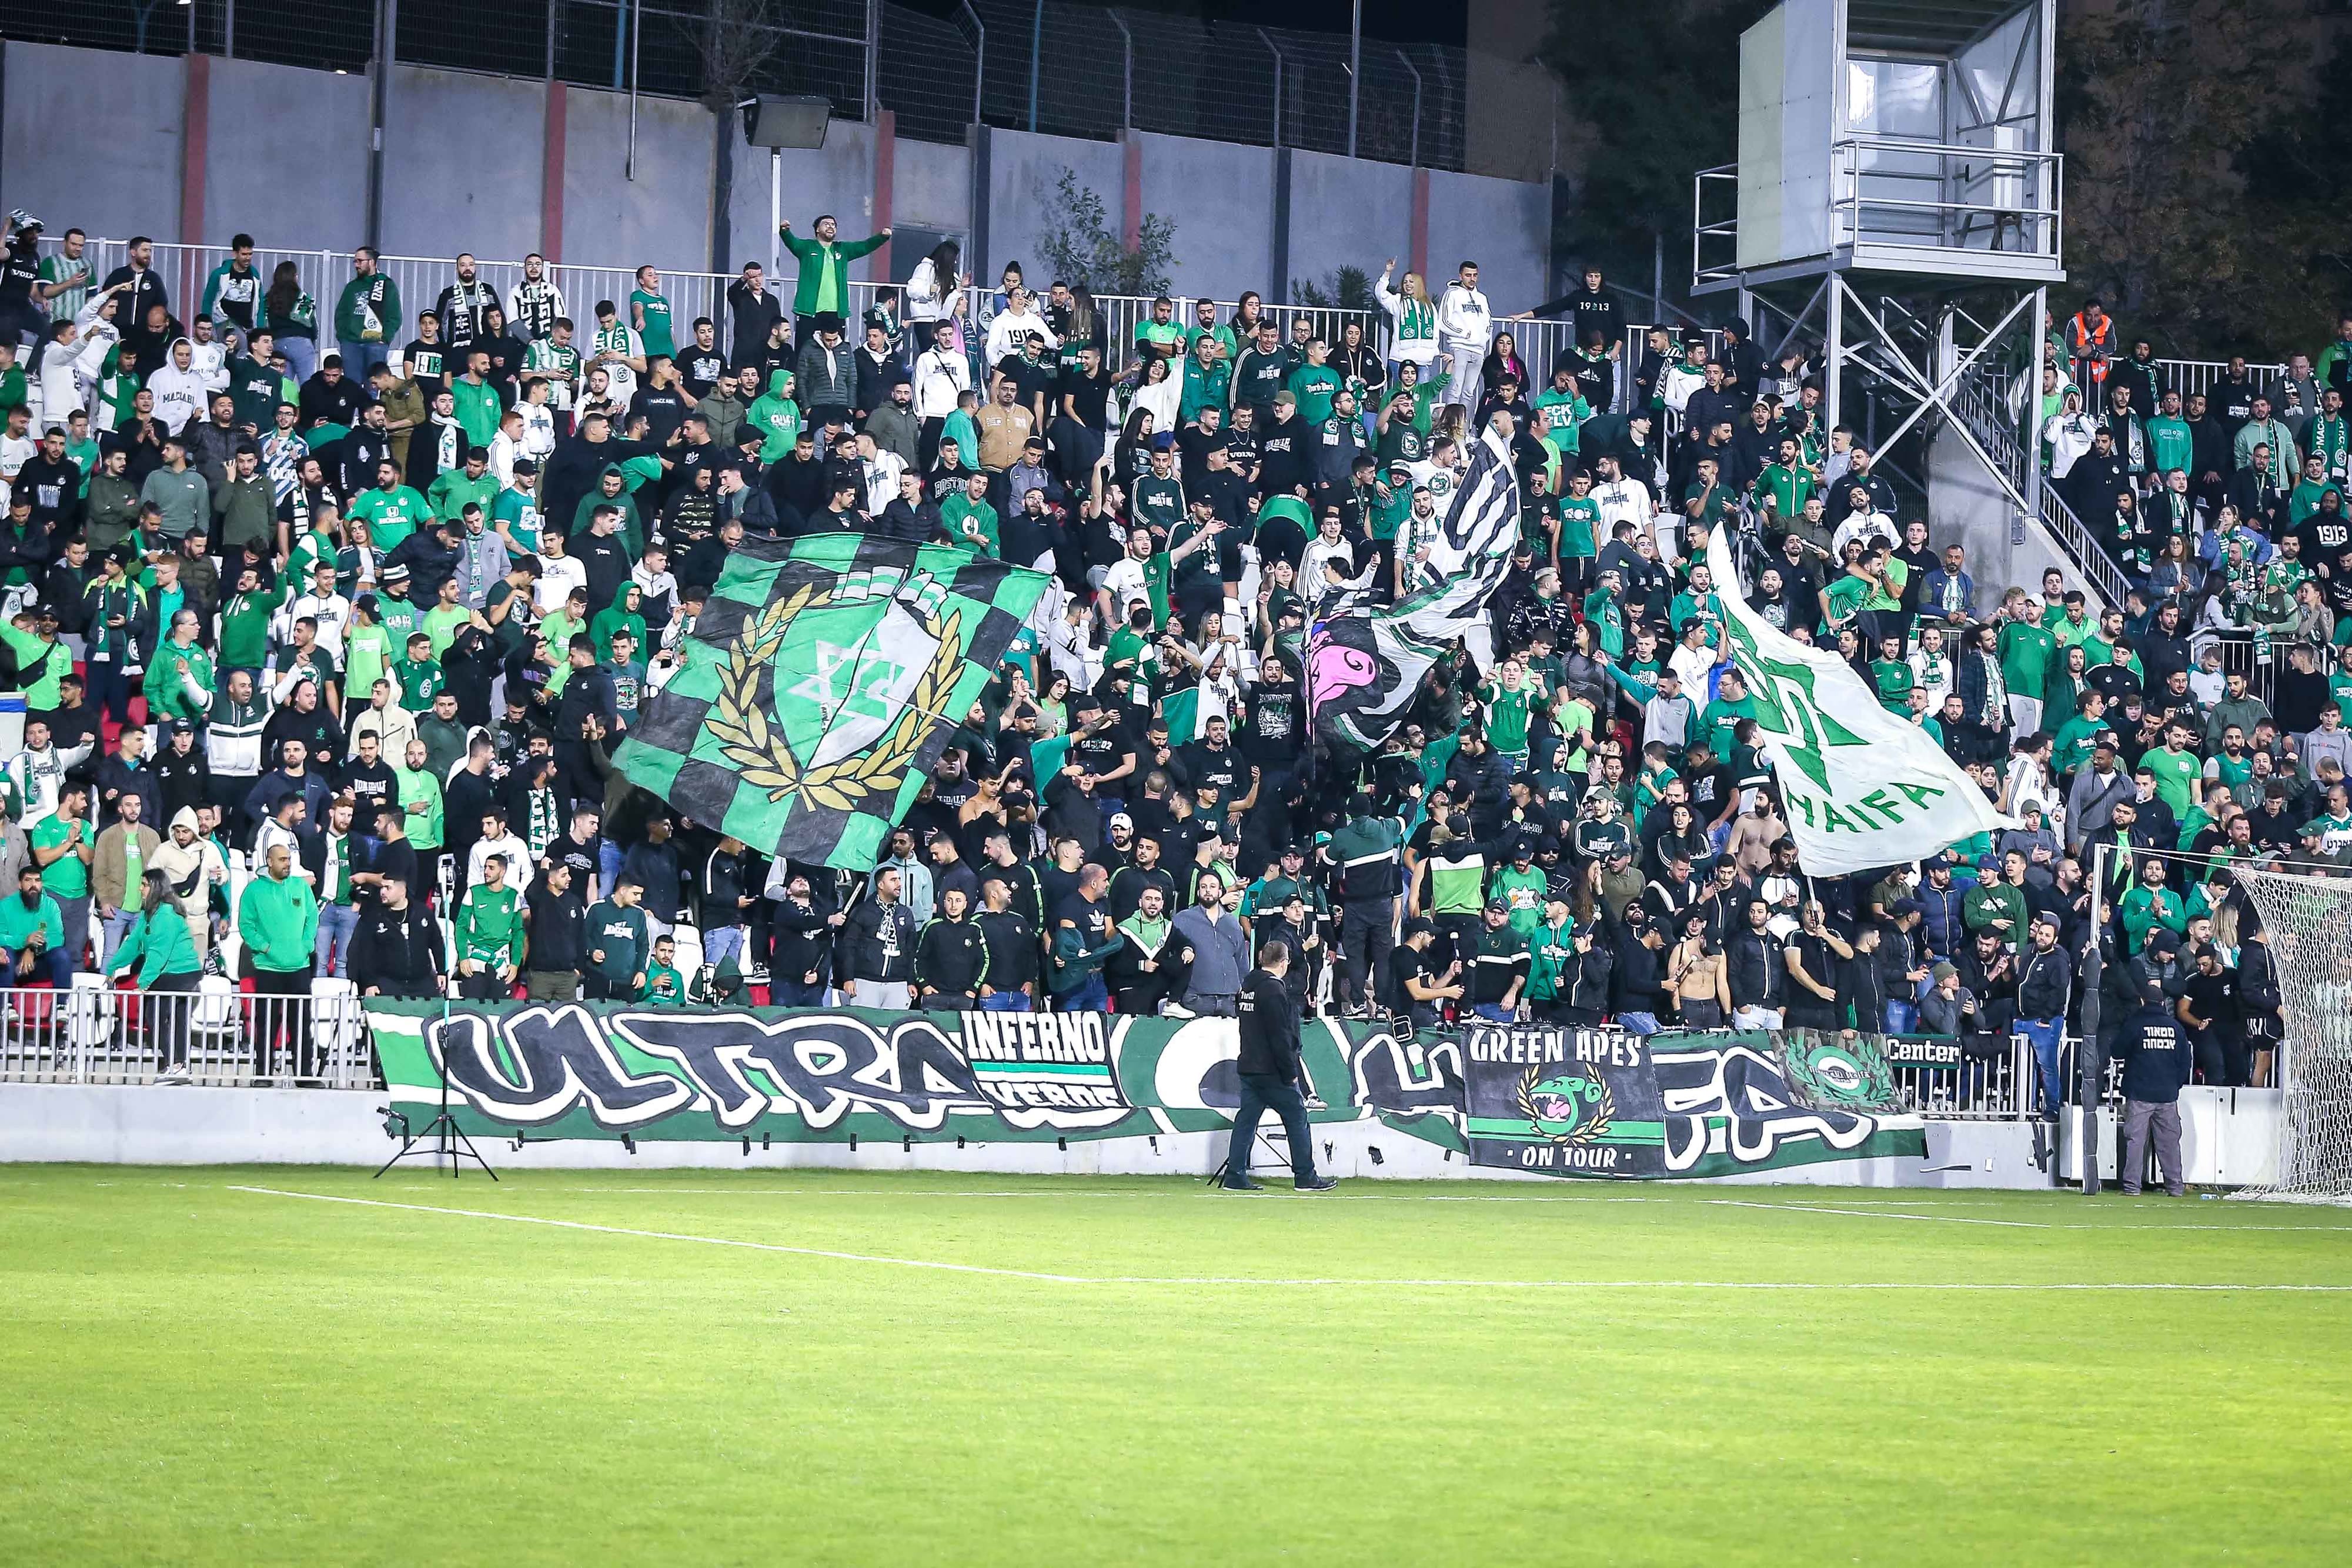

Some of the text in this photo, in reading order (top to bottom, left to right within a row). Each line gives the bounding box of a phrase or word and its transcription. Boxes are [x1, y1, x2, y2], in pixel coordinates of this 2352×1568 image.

[11, 268, 36, 280] VOLV
[1579, 302, 1609, 312] 19 13
[163, 391, 195, 404] MACCABI
[1229, 452, 1255, 460] VOLV
[2317, 524, 2348, 542] 1913
[1132, 579, 1161, 589] VOLVO
[1783, 781, 1945, 833] HAIFA
[962, 1011, 1105, 1062] INFERNO
[2143, 1026, 2175, 1038] מטאור
[1470, 1028, 1641, 1067] GREEN APES
[1887, 1038, 1959, 1063] Center
[427, 1004, 1134, 1129] ULTRA
[982, 1082, 1118, 1109] VERDE
[1521, 1146, 1618, 1168] ON TOUR
